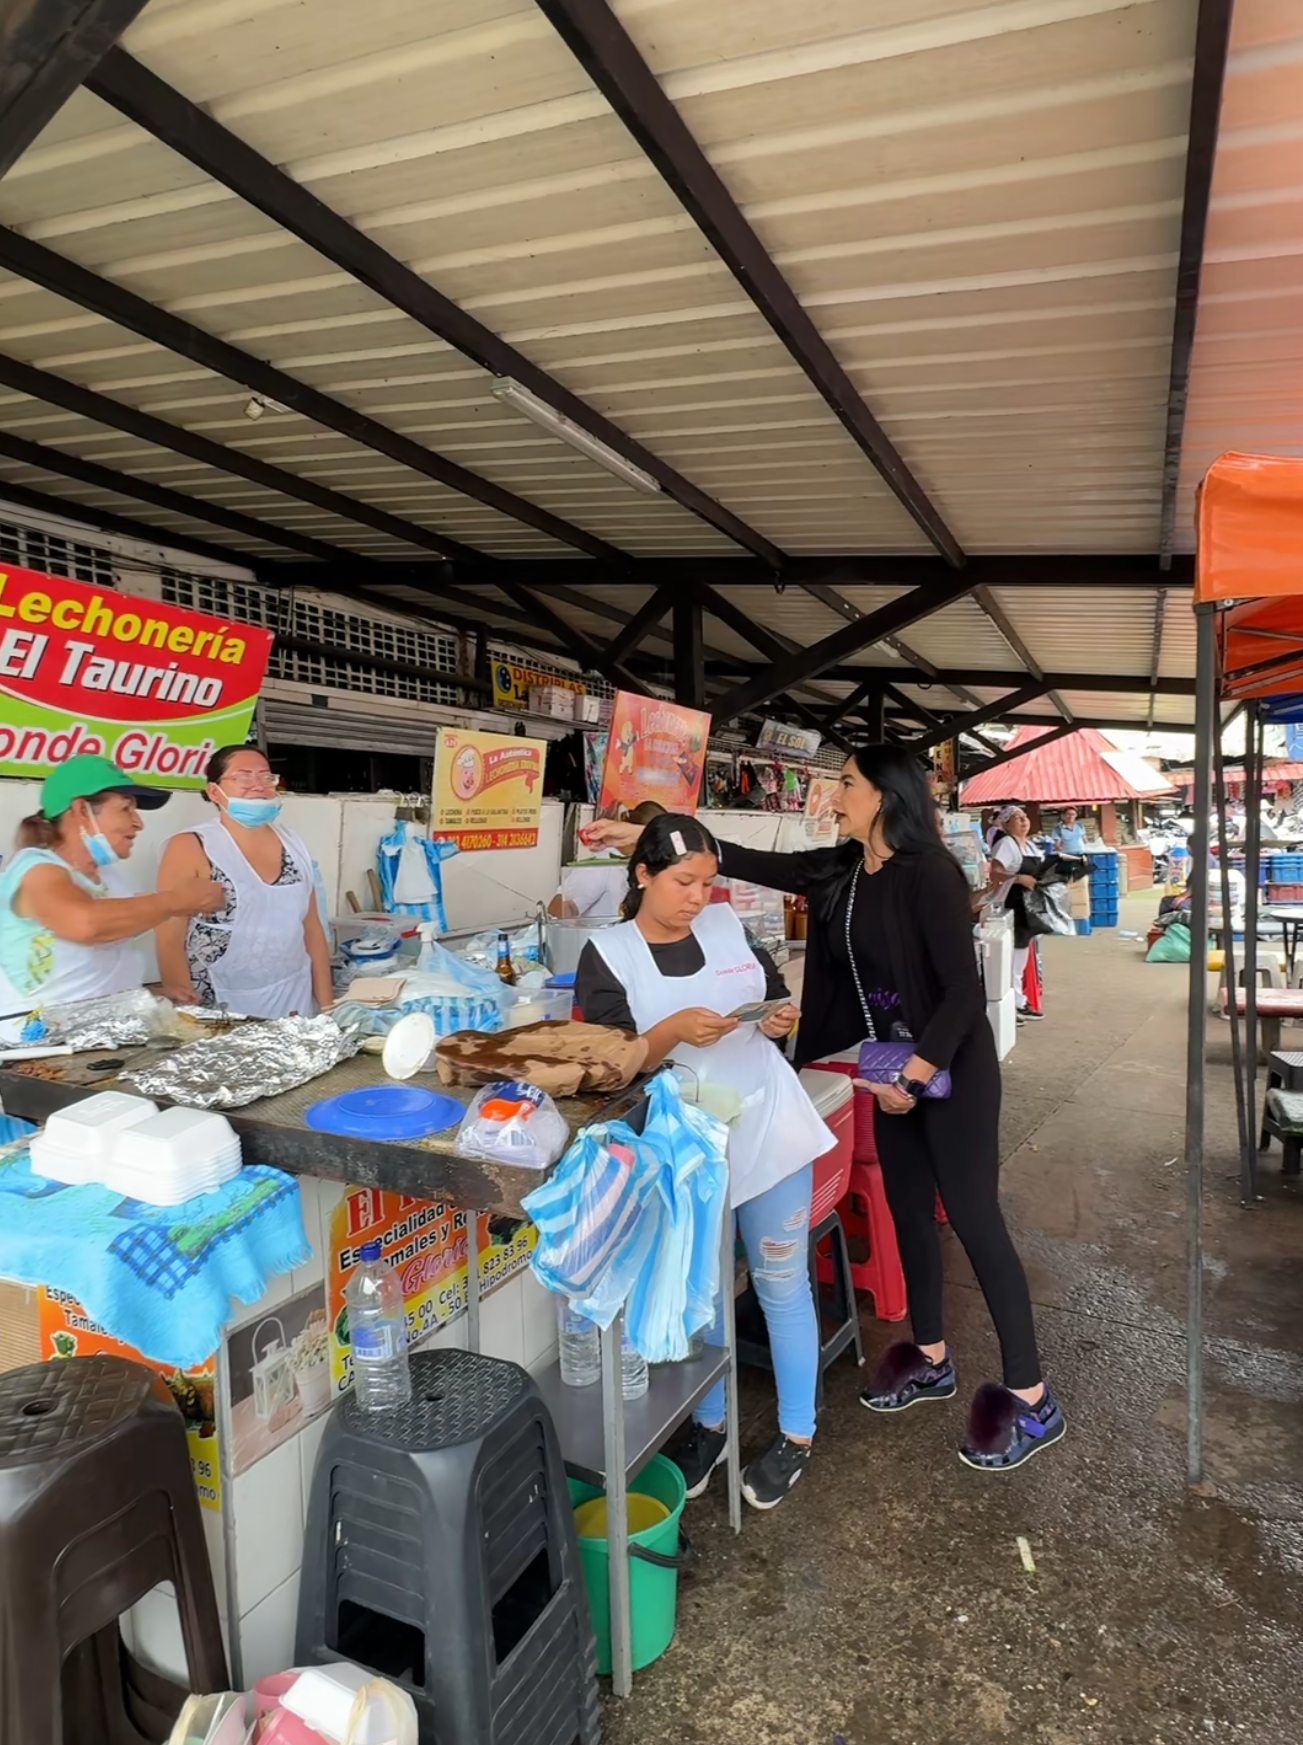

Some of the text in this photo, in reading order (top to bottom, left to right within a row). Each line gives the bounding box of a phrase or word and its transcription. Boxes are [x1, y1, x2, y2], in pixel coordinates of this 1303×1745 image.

[0, 572, 246, 664] Lechonería
[0, 628, 224, 708] El Taurino
[489, 755, 498, 765] La
[777, 730, 806, 749] EL SOL
[346, 1187, 383, 1236] El
[340, 1202, 444, 1270] Esecialidad
[383, 1222, 449, 1268] males y
[419, 1300, 433, 1318] 00
[517, 1236, 528, 1251] 96
[480, 1250, 532, 1292] Hipodromo
[199, 1460, 212, 1478] 96
